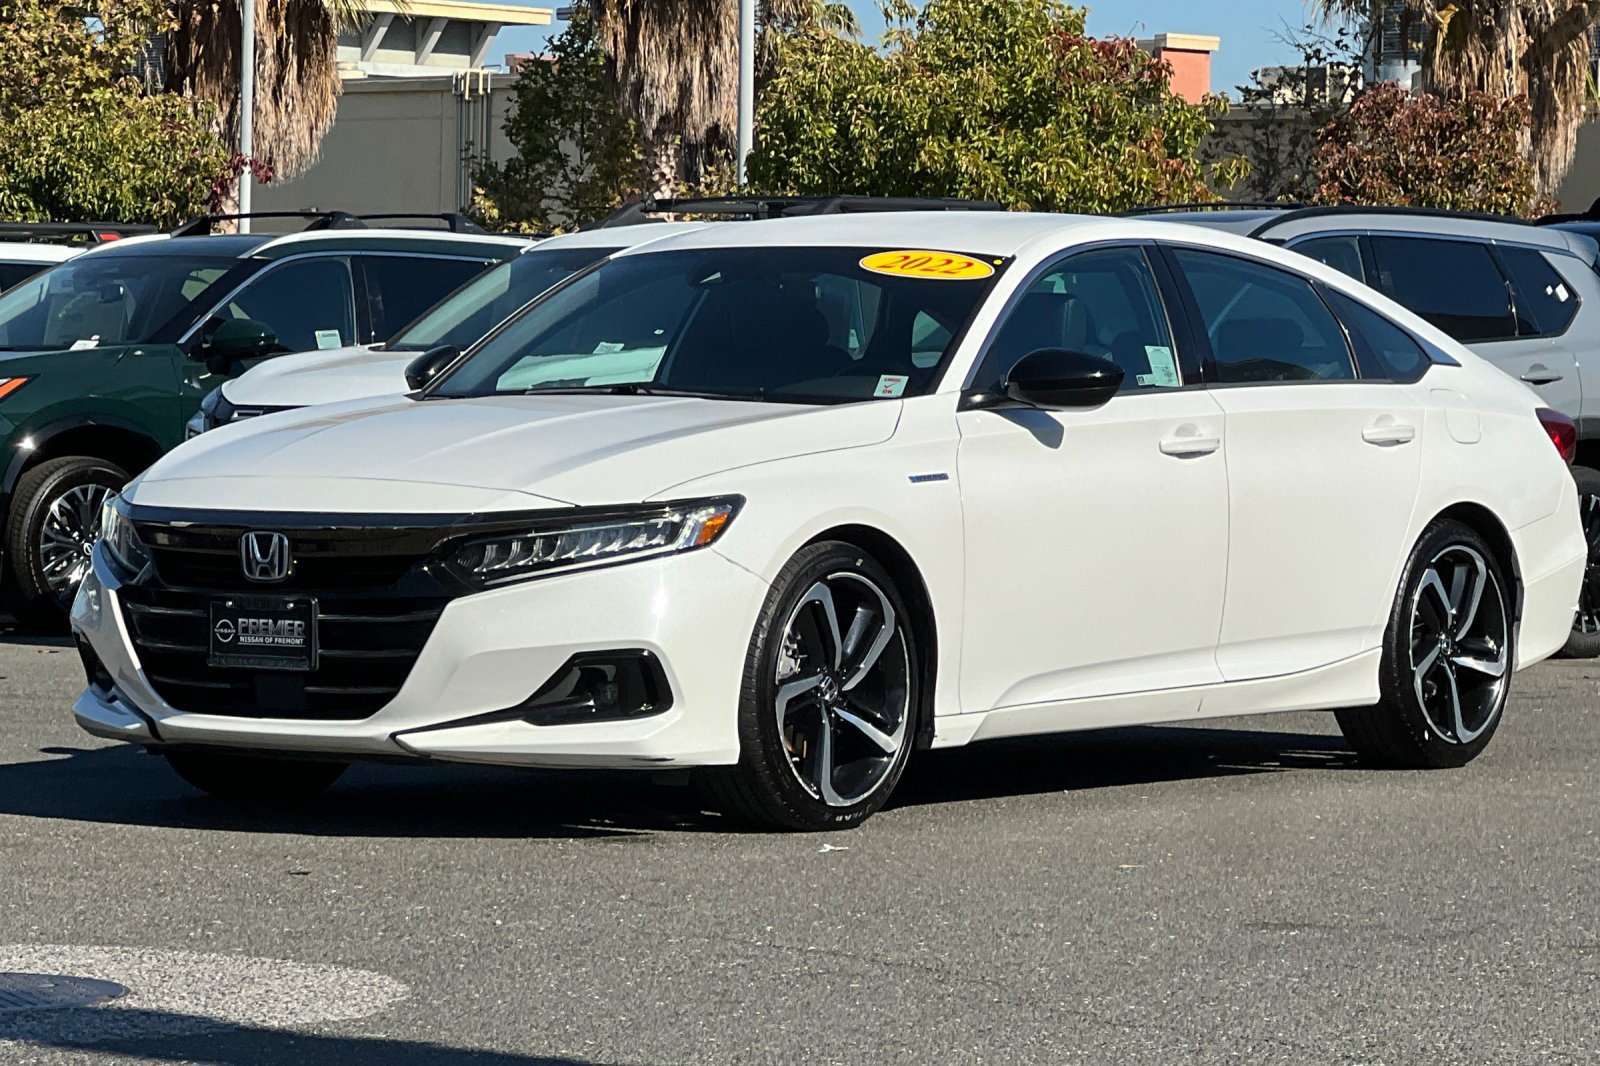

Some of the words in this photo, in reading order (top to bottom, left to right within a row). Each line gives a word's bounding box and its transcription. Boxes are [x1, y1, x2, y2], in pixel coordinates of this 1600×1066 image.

[875, 255, 973, 274] 2022
[238, 618, 305, 635] PREMIER
[275, 637, 304, 645] FREMONT
